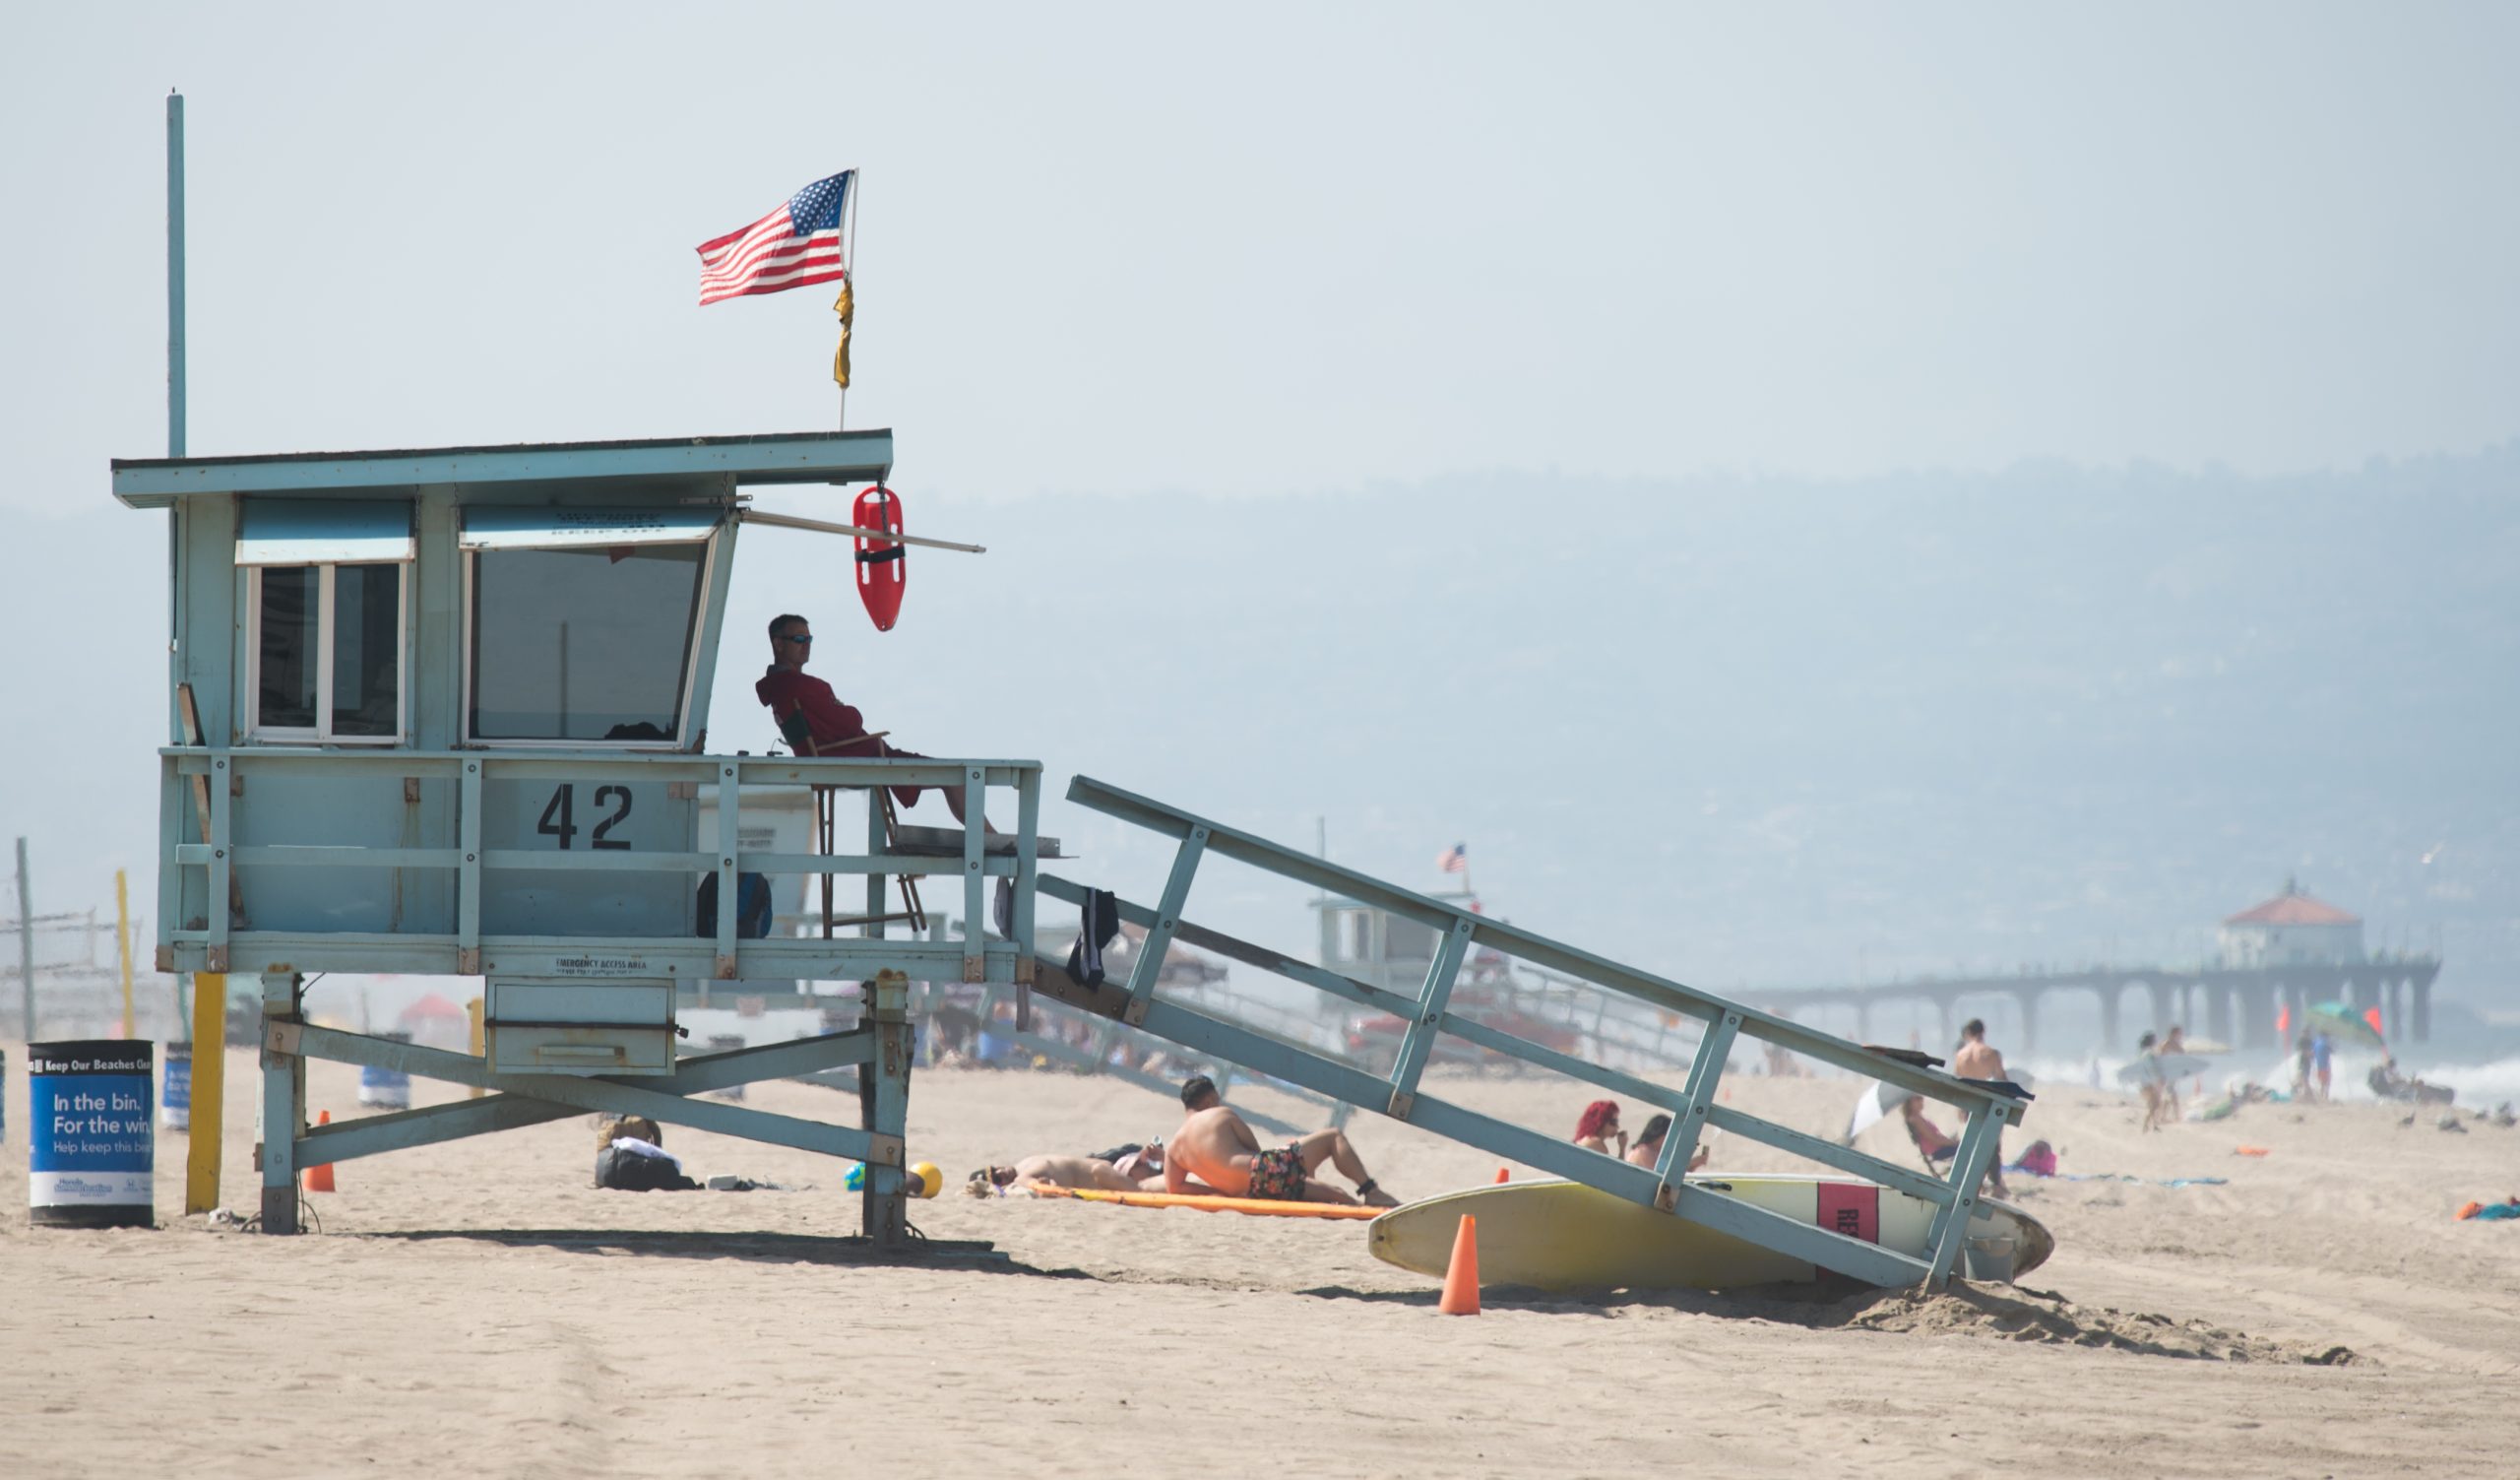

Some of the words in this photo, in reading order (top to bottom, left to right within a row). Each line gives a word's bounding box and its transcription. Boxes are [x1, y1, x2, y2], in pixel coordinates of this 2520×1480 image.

[537, 783, 633, 850] 42
[556, 958, 598, 968] EMERGENCY
[600, 960, 626, 969] ACCESS
[627, 961, 647, 970] AREA
[45, 1061, 69, 1073] Keep
[71, 1061, 90, 1070] Our
[94, 1059, 135, 1070] Beaches
[54, 1094, 69, 1111] In
[74, 1094, 105, 1111] the
[112, 1093, 141, 1111] bin.
[54, 1116, 84, 1133] For
[89, 1116, 120, 1133] the
[54, 1141, 78, 1155] Help
[81, 1141, 111, 1155] keep
[114, 1141, 132, 1153] this
